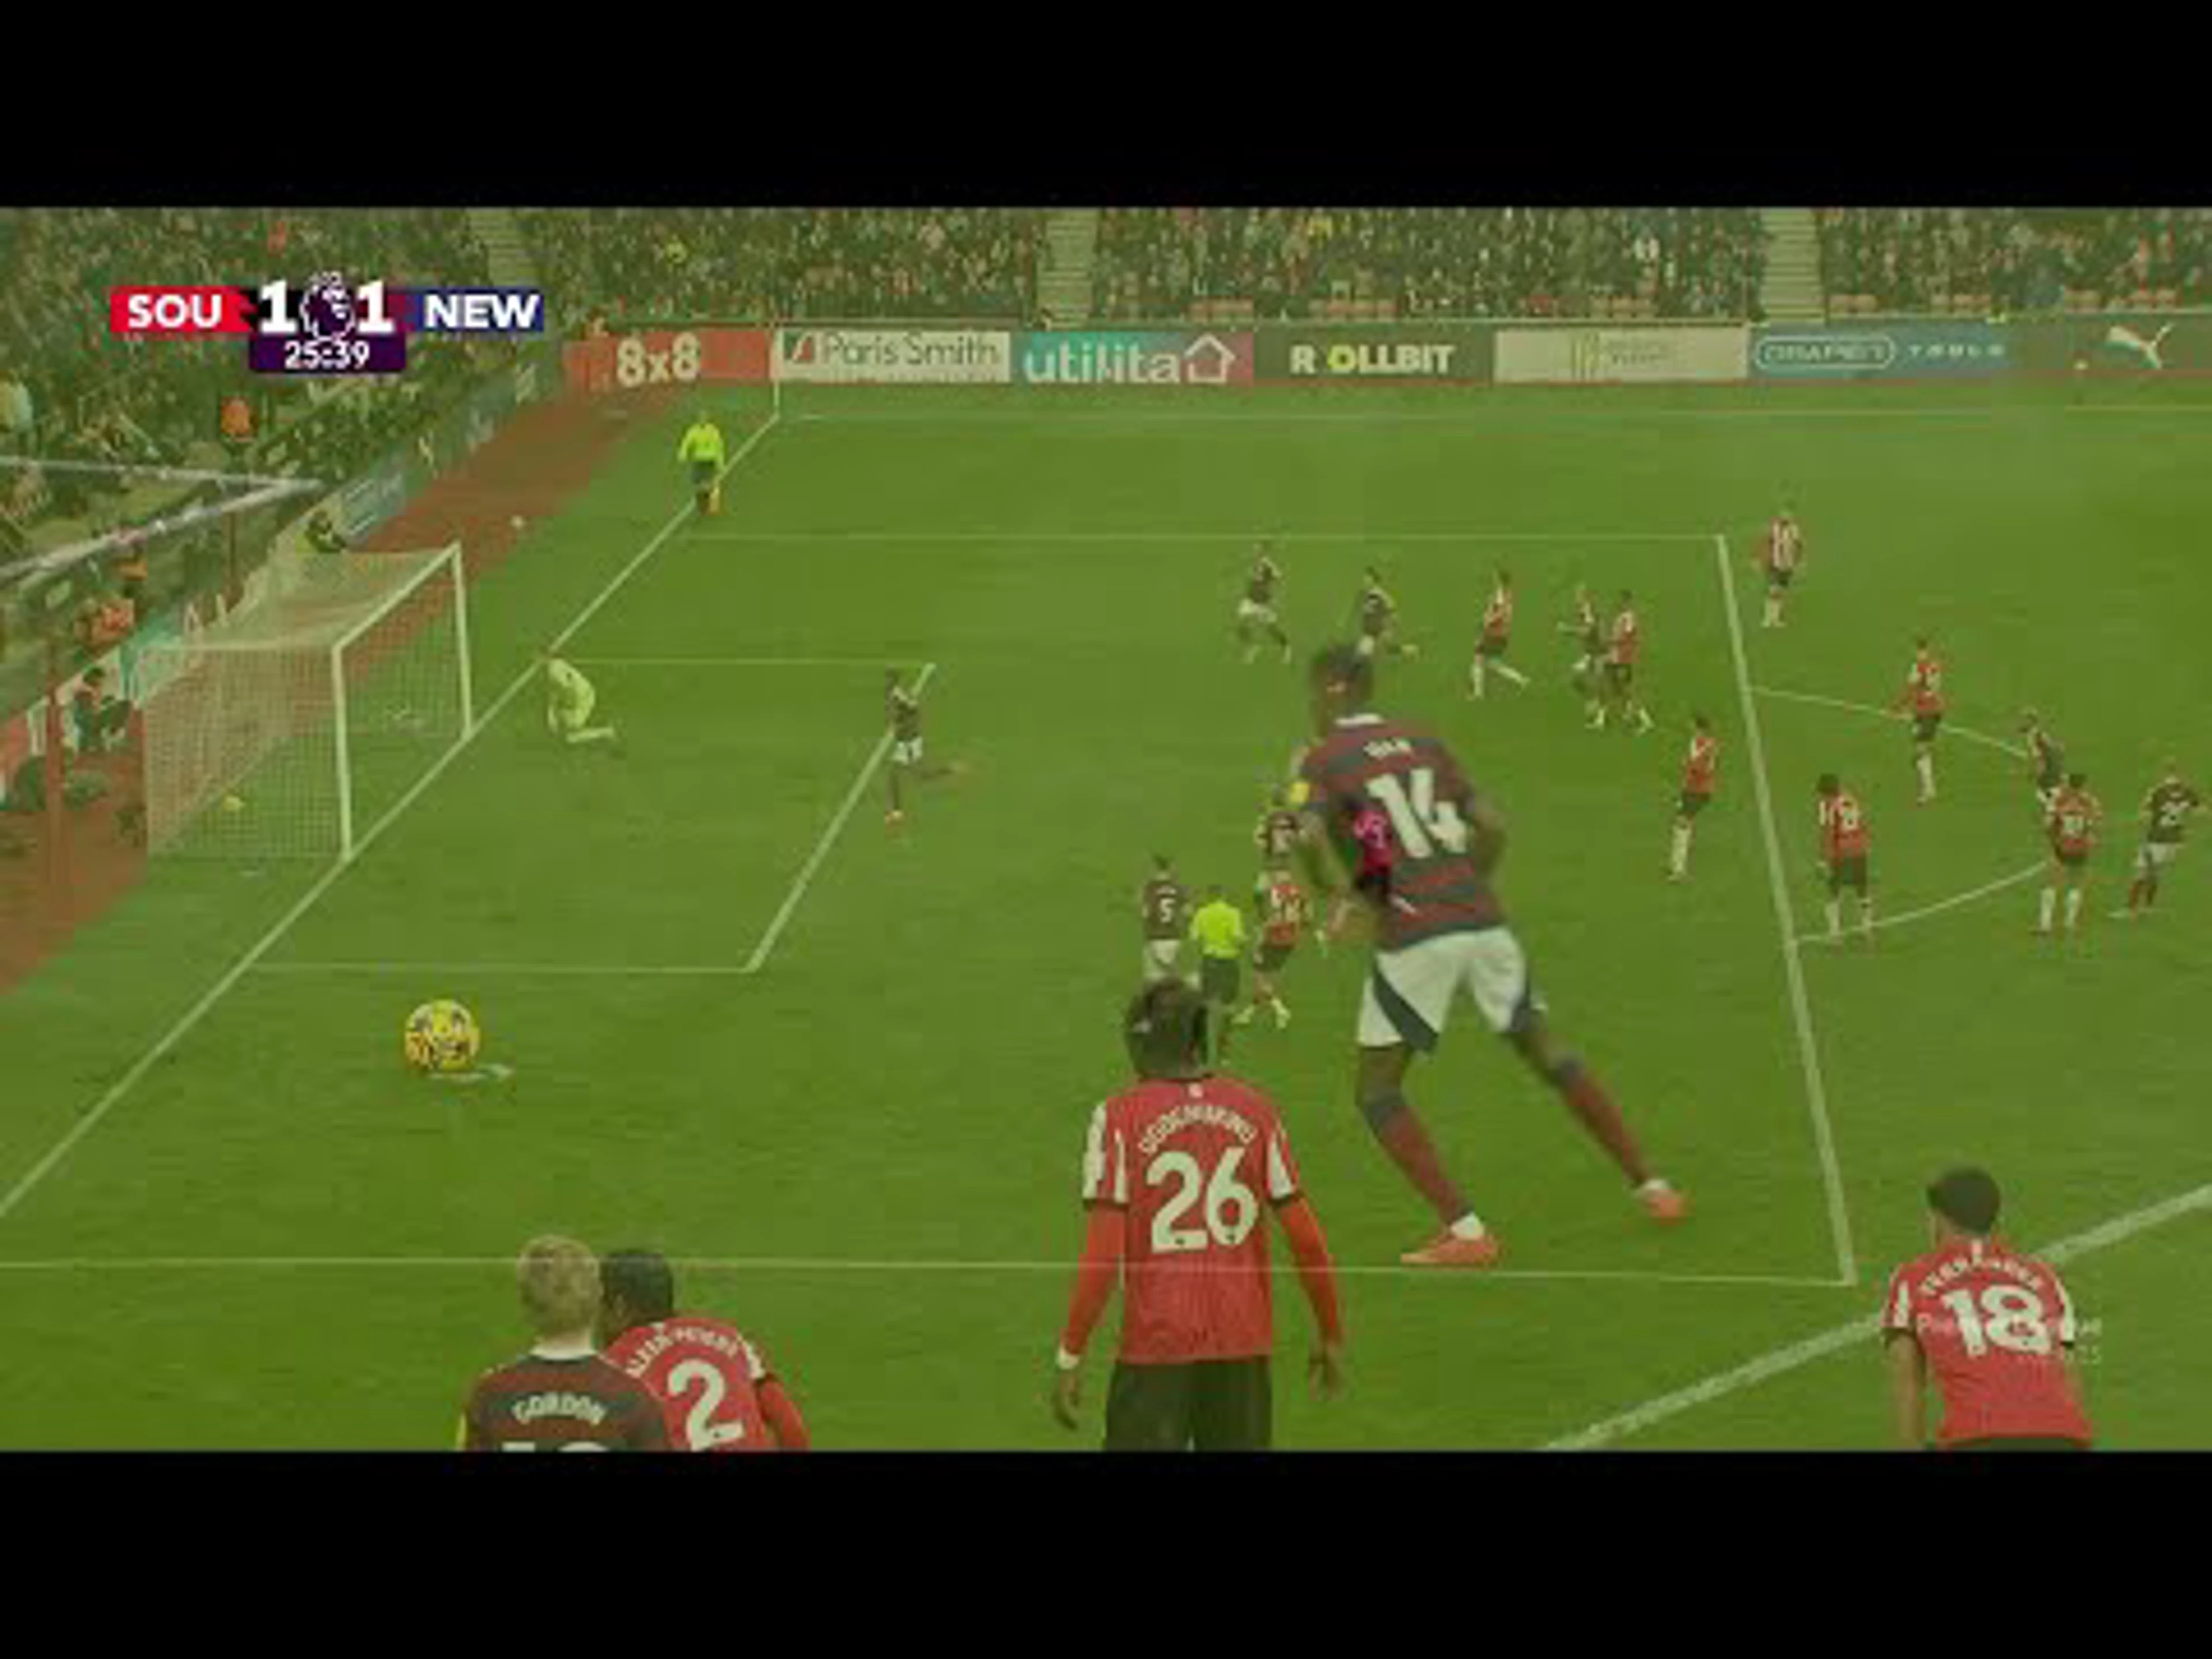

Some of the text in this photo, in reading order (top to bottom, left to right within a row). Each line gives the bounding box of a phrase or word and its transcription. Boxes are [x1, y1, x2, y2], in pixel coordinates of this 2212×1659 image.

[617, 332, 701, 388] 8x8
[825, 329, 998, 365] Paris Smith
[1023, 341, 1181, 383] utilita
[1289, 344, 1456, 374] ROLLBIT
[1365, 768, 1467, 858] 14
[1146, 1146, 1259, 1253] 26
[1943, 1284, 2052, 1358] 18
[666, 1358, 745, 1451] 2
